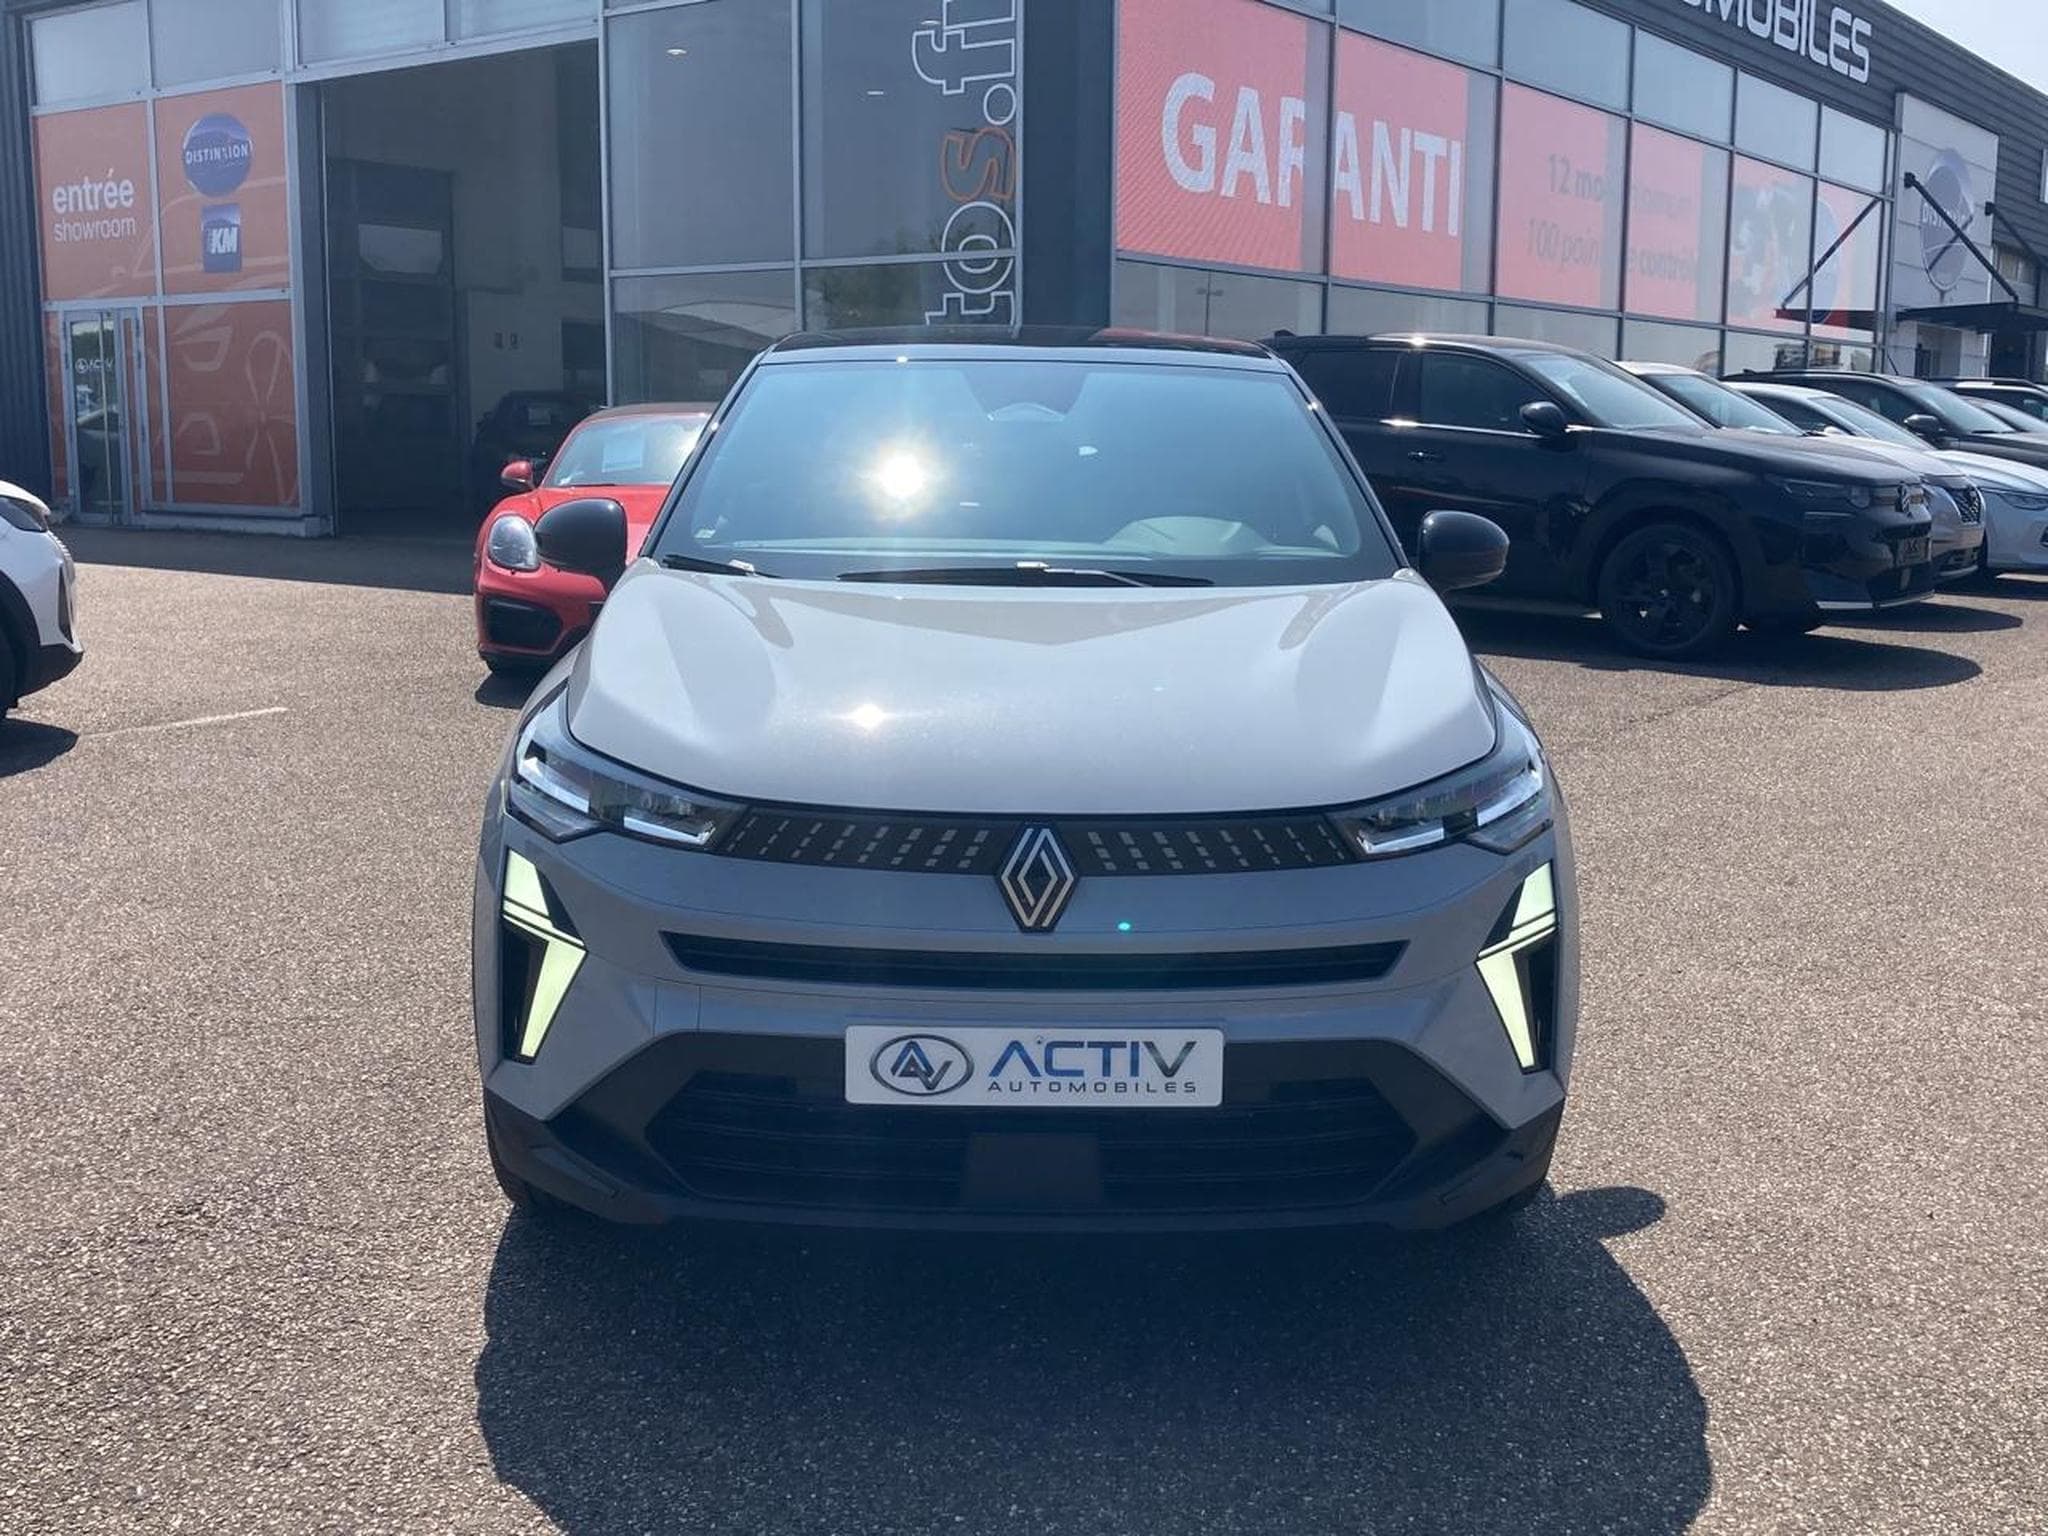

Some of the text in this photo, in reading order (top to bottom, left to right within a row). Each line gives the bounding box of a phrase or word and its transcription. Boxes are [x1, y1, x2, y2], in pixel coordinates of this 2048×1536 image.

[52, 167, 134, 214] entrée
[54, 215, 136, 243] showroom
[211, 226, 238, 255] KM
[988, 1039, 1197, 1078] ACTIV
[987, 1081, 1197, 1094] AUTOMOBILES
